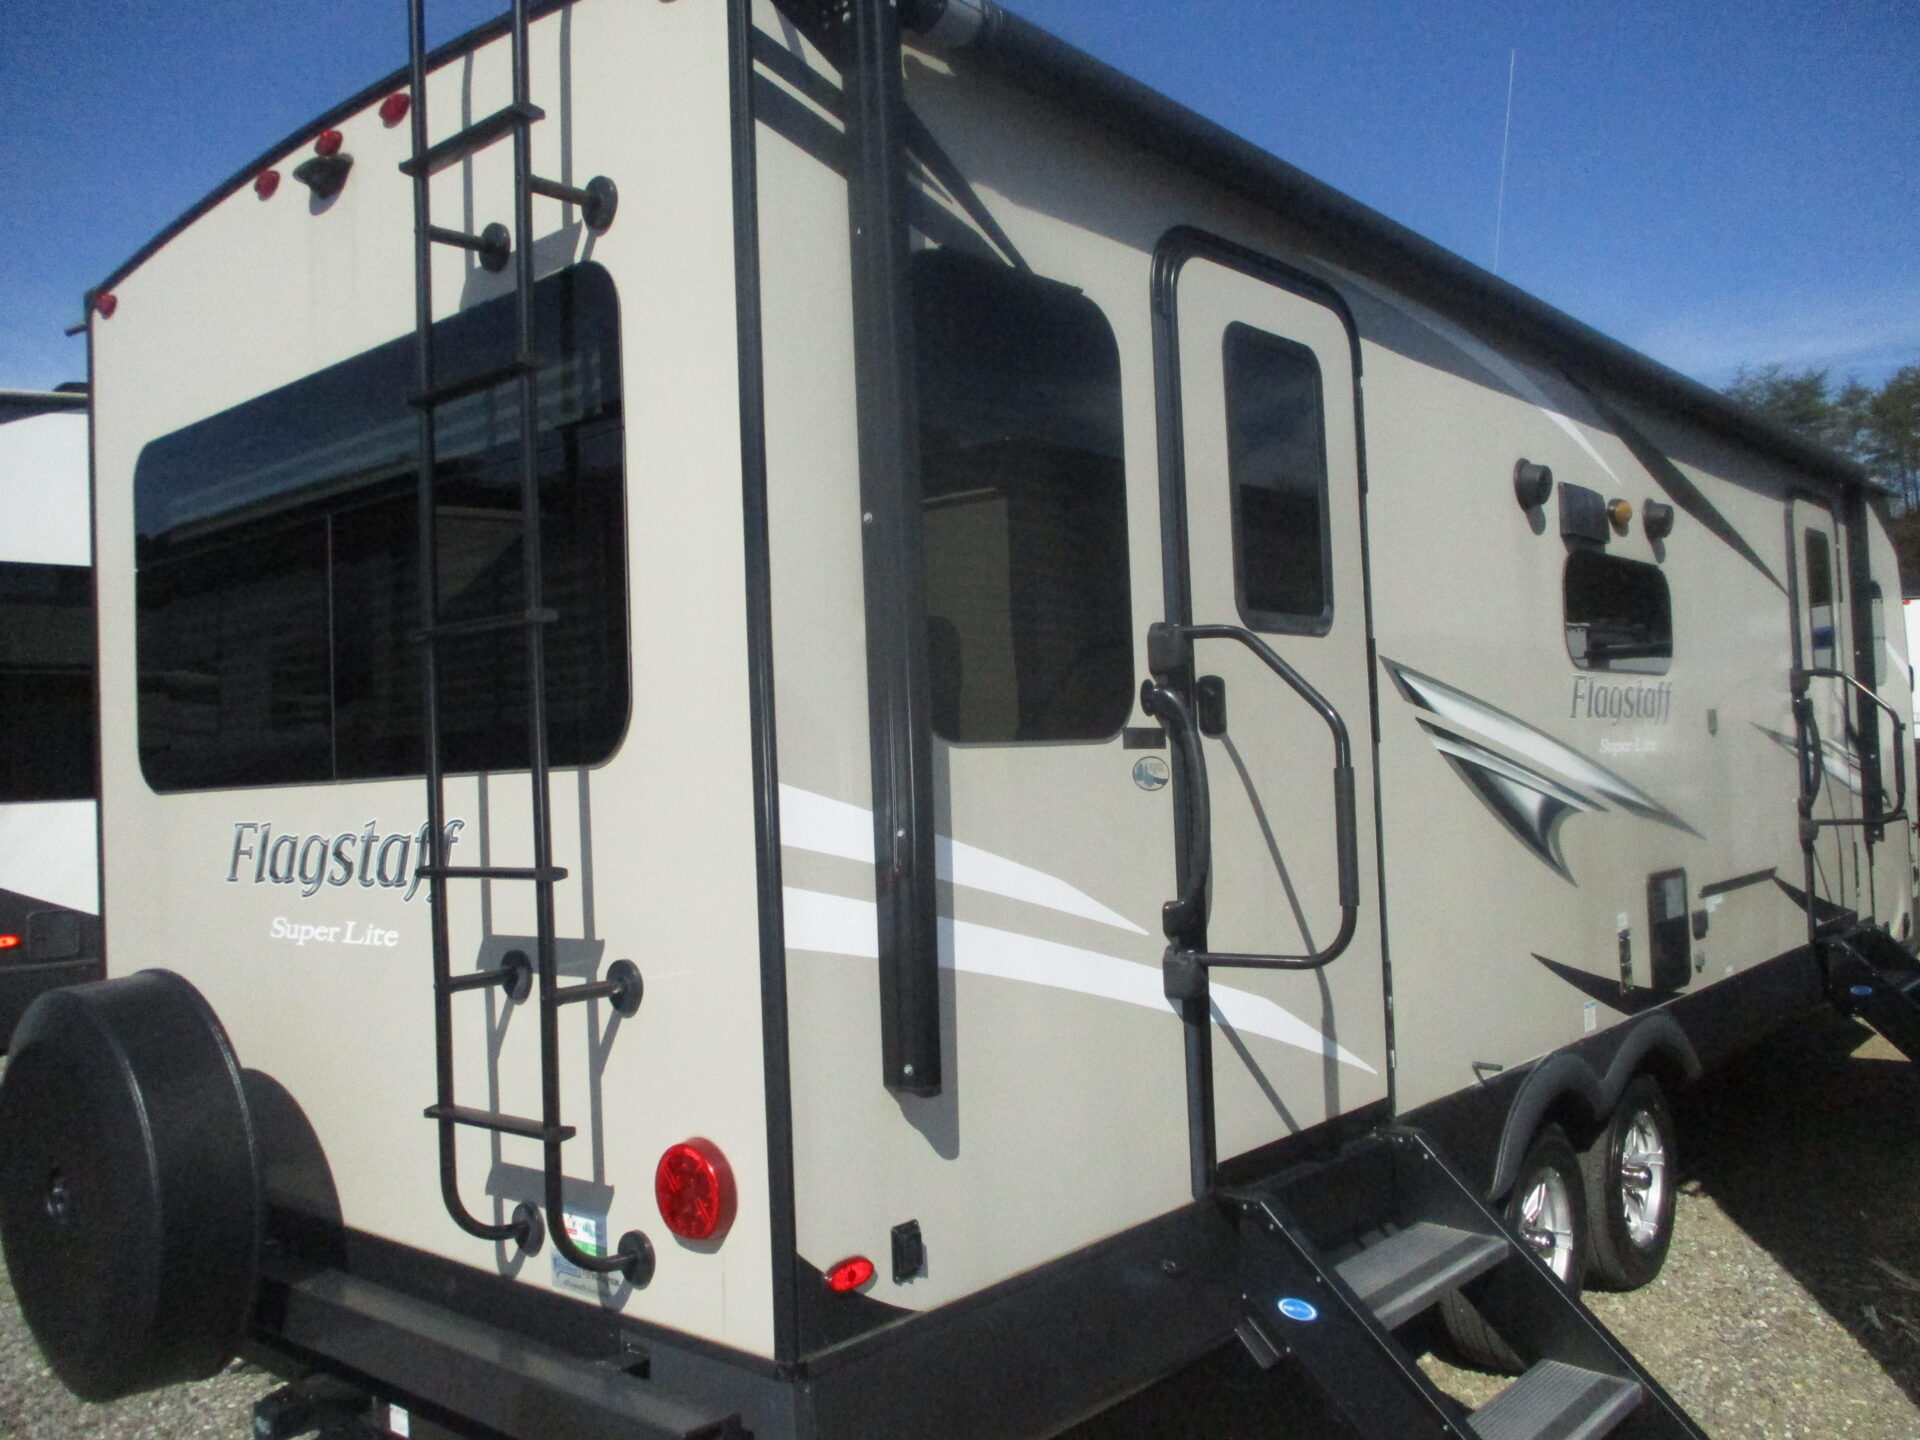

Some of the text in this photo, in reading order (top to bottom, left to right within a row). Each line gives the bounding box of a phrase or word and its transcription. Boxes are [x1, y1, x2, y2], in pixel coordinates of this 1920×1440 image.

[1569, 675, 1674, 726] Flagstaff
[270, 917, 400, 947] Super Lite
